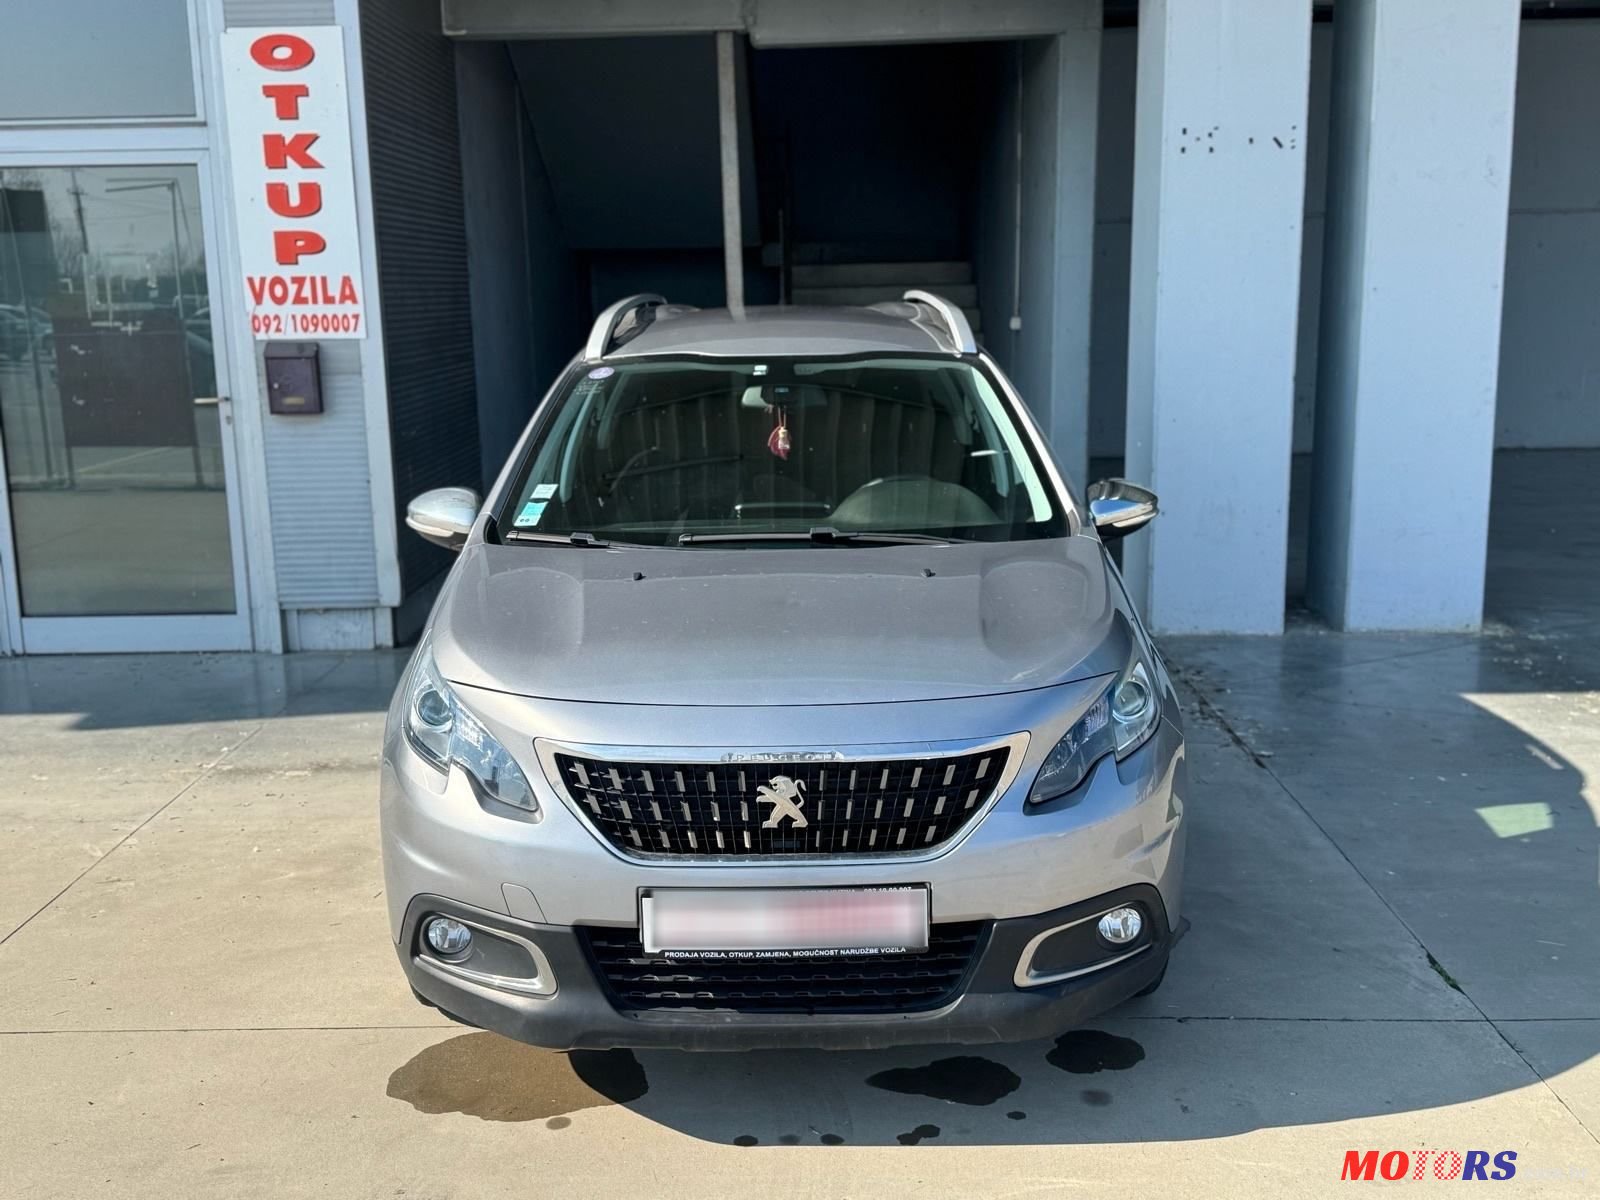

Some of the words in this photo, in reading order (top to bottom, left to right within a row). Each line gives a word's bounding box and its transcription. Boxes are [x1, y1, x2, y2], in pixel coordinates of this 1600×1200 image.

[250, 33, 326, 265] OTKUP
[247, 275, 358, 305] VOZILA
[251, 313, 360, 334] 092/1090007
